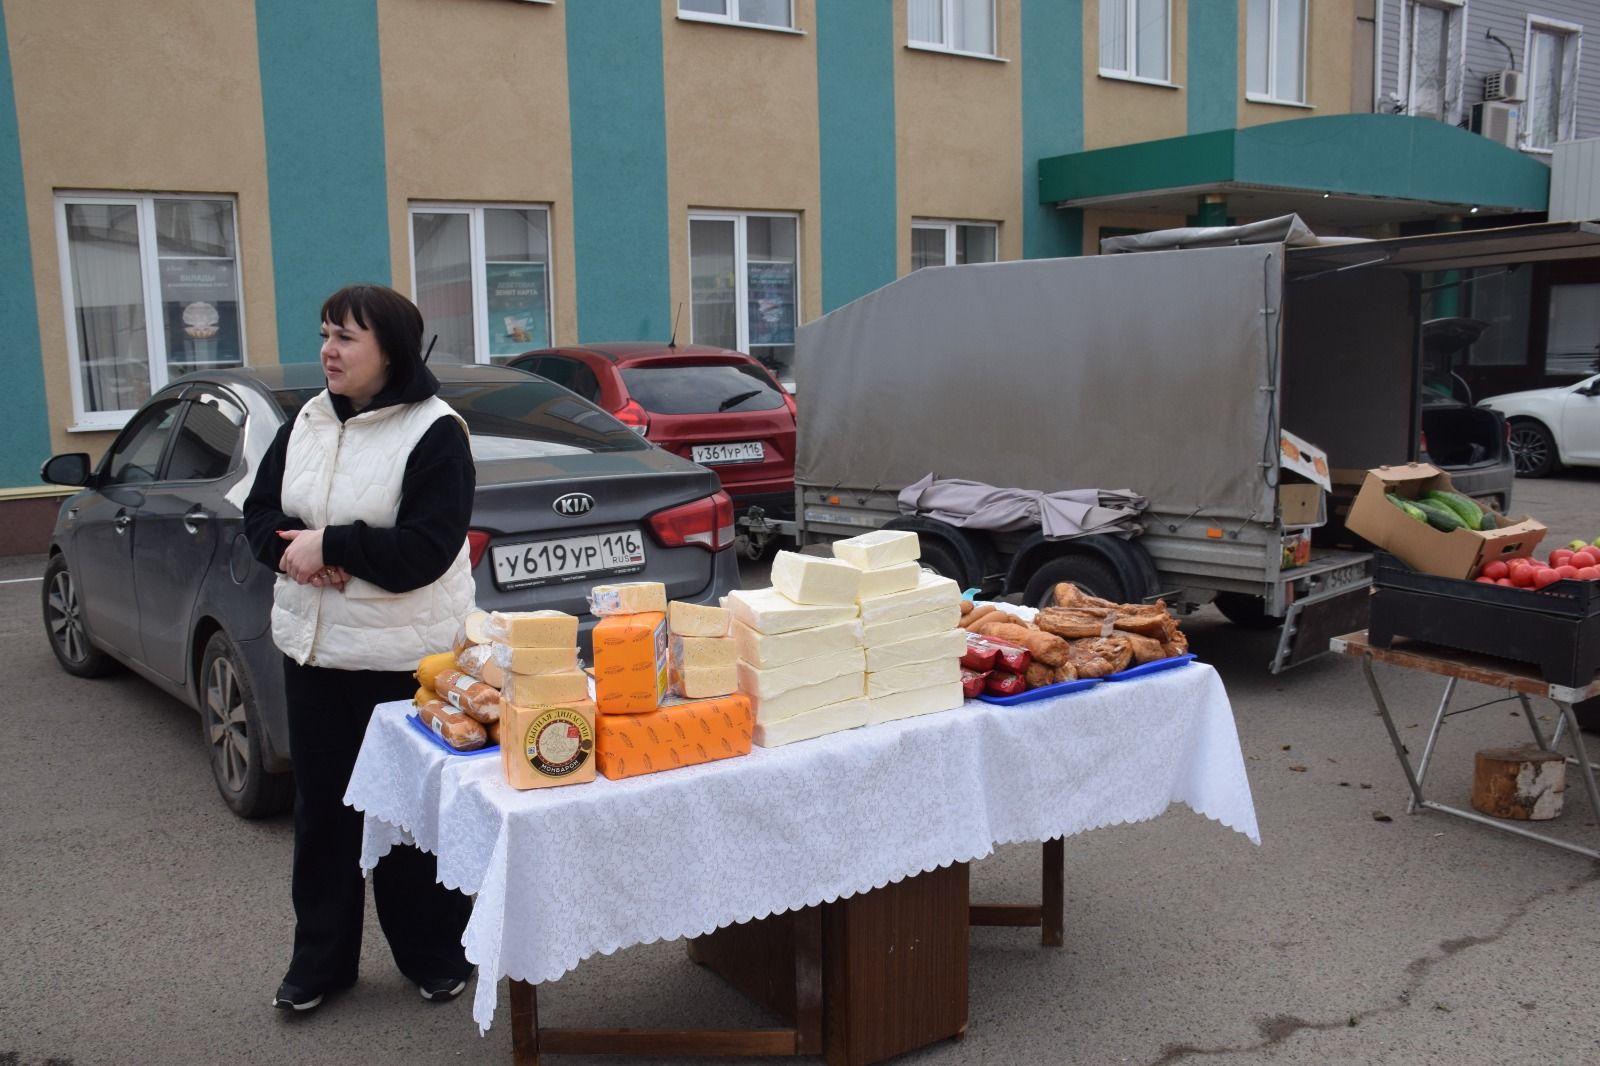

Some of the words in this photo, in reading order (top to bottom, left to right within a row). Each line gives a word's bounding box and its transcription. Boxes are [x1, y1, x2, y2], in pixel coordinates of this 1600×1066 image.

[561, 497, 590, 513] KIA
[505, 544, 598, 577] У619УР
[602, 534, 638, 556] 116
[612, 555, 630, 564] RUS
[528, 713, 552, 744] СЫРНАЯ
[541, 760, 579, 773] МОНБАРОН
